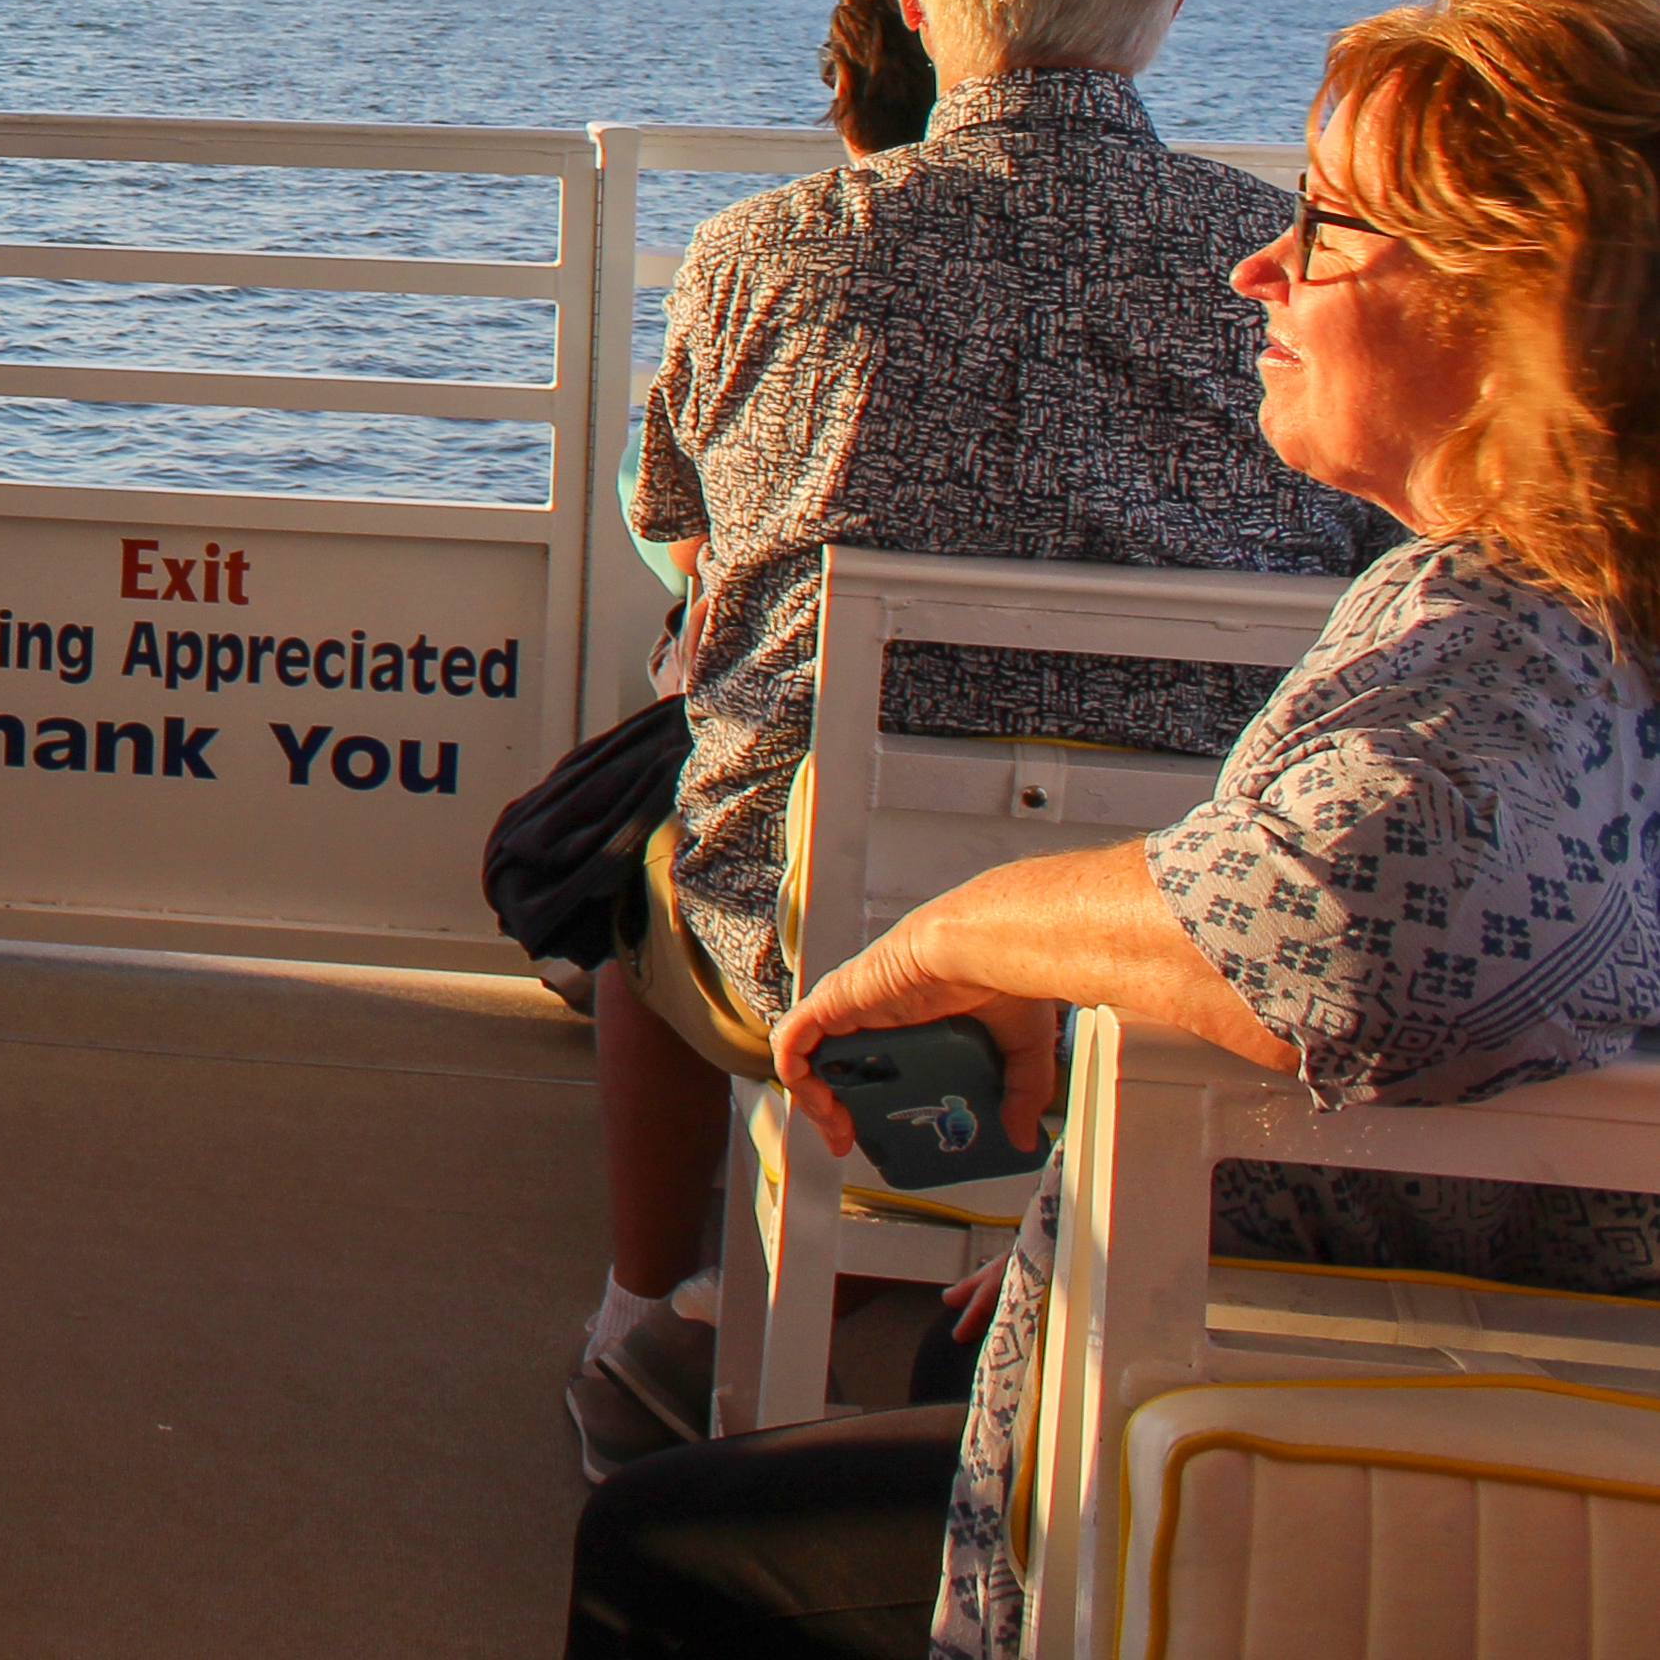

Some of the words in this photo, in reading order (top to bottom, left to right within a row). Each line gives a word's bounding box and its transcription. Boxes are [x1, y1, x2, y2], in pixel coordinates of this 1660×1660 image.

[120, 539, 250, 604] Exit
[121, 621, 519, 699] Appreciated
[269, 722, 460, 796] You
